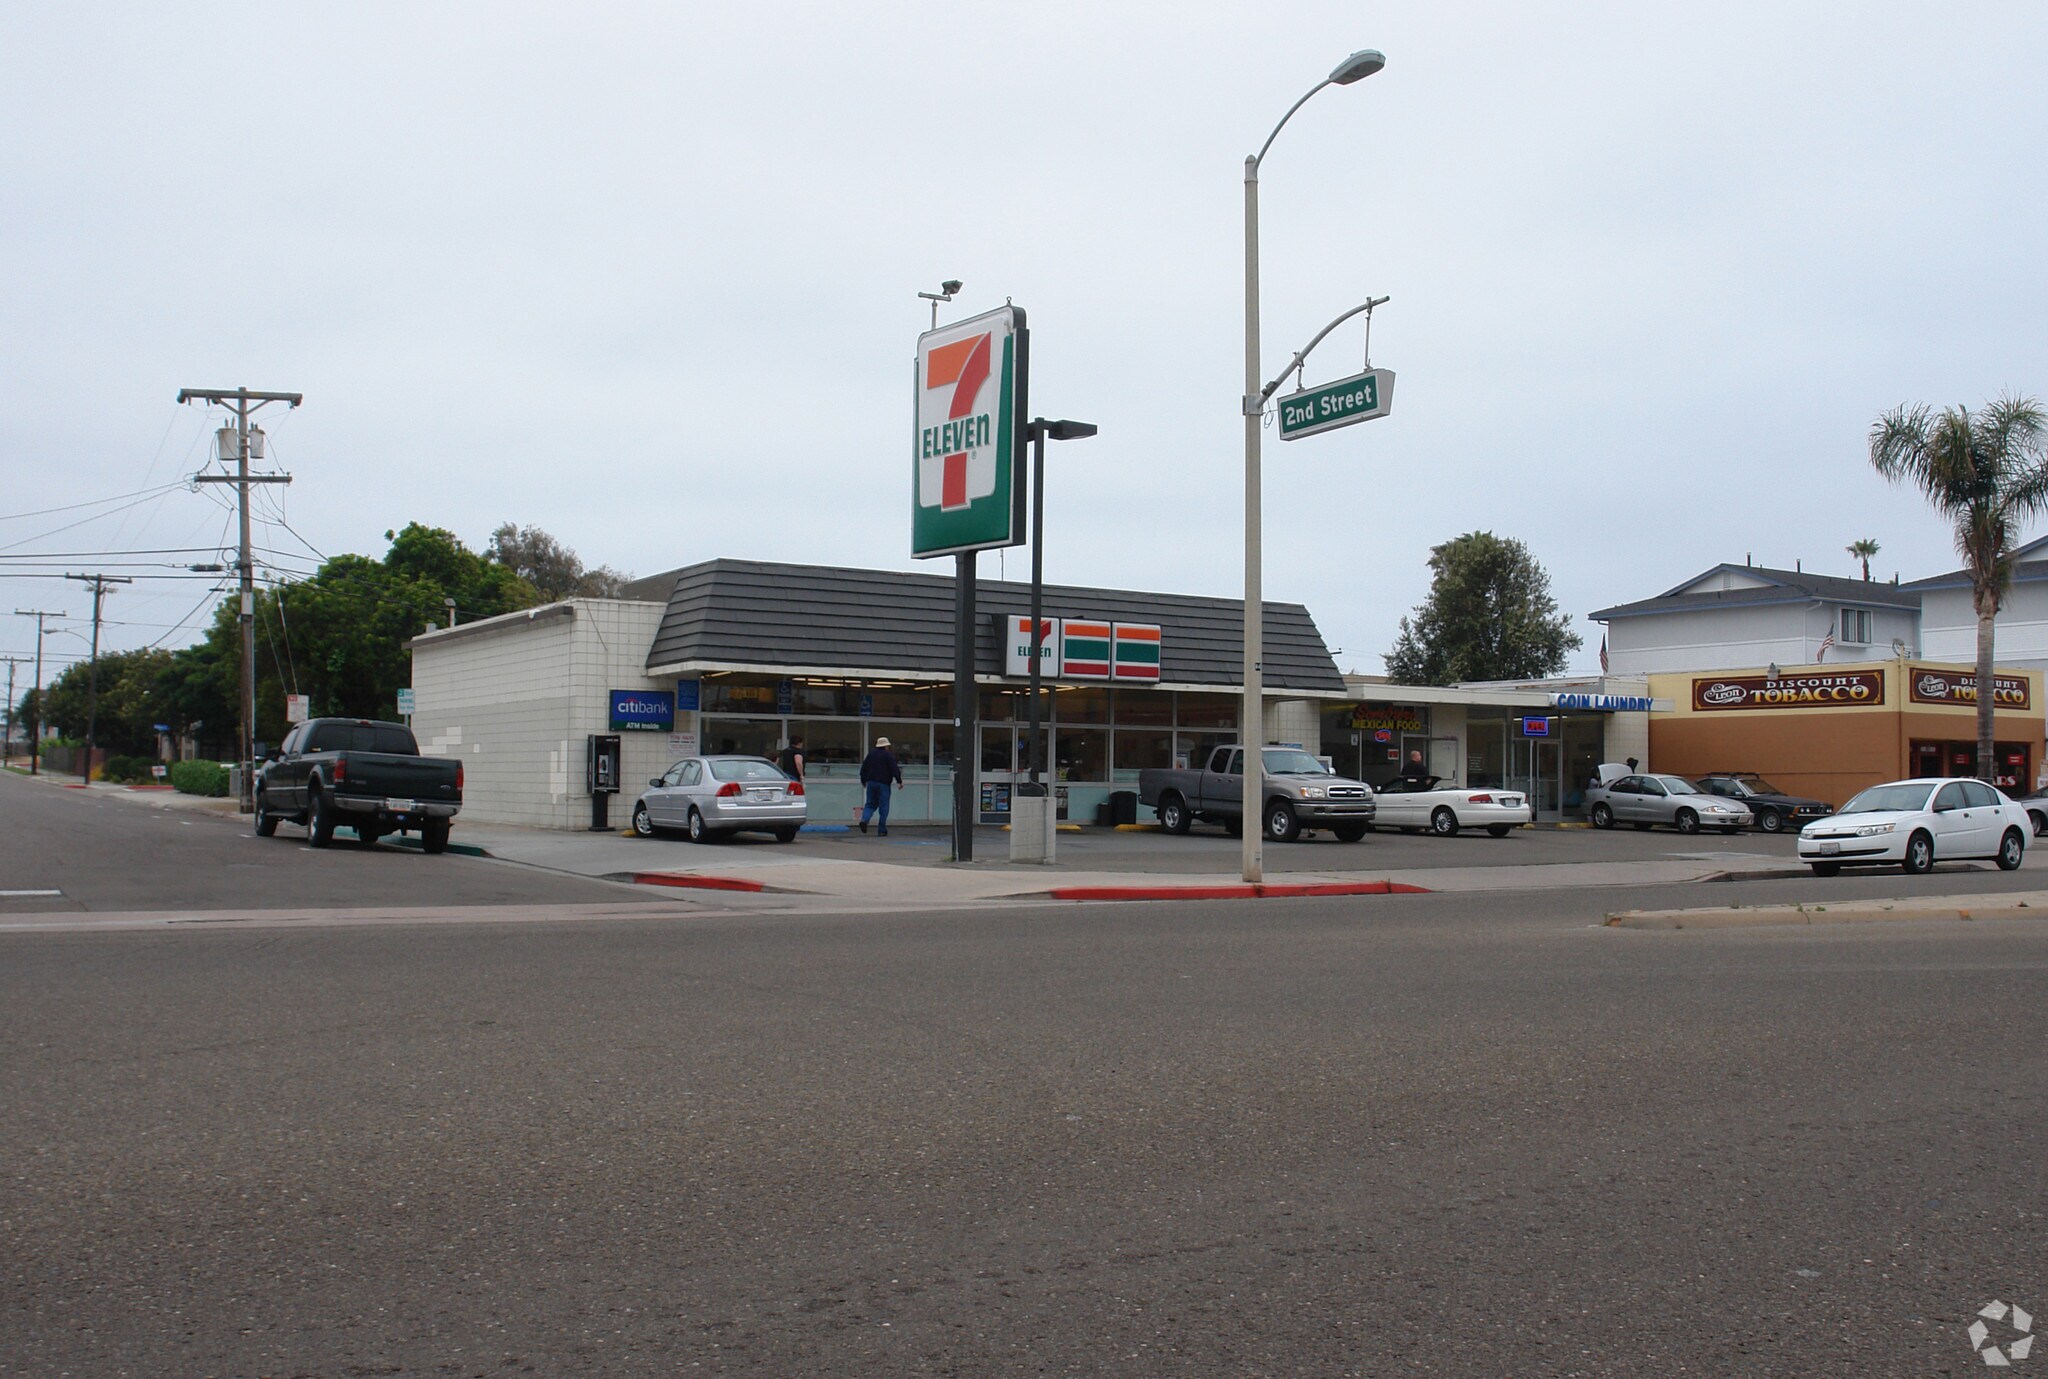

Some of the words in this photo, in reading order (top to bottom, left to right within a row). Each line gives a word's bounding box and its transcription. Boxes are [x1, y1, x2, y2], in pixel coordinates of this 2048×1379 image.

[1285, 401, 1314, 426] 2nd
[1320, 384, 1372, 416] Street
[1766, 677, 1860, 688] DISCOUNT
[1557, 693, 1590, 709] COIN
[1595, 695, 1654, 712] LAUNDRY
[1750, 684, 1870, 703] TOBACCO
[1951, 685, 2024, 703] TOCCO
[617, 700, 668, 714] citibank
[1352, 718, 1394, 729] MEXICAN
[1396, 720, 1421, 730] FOOD
